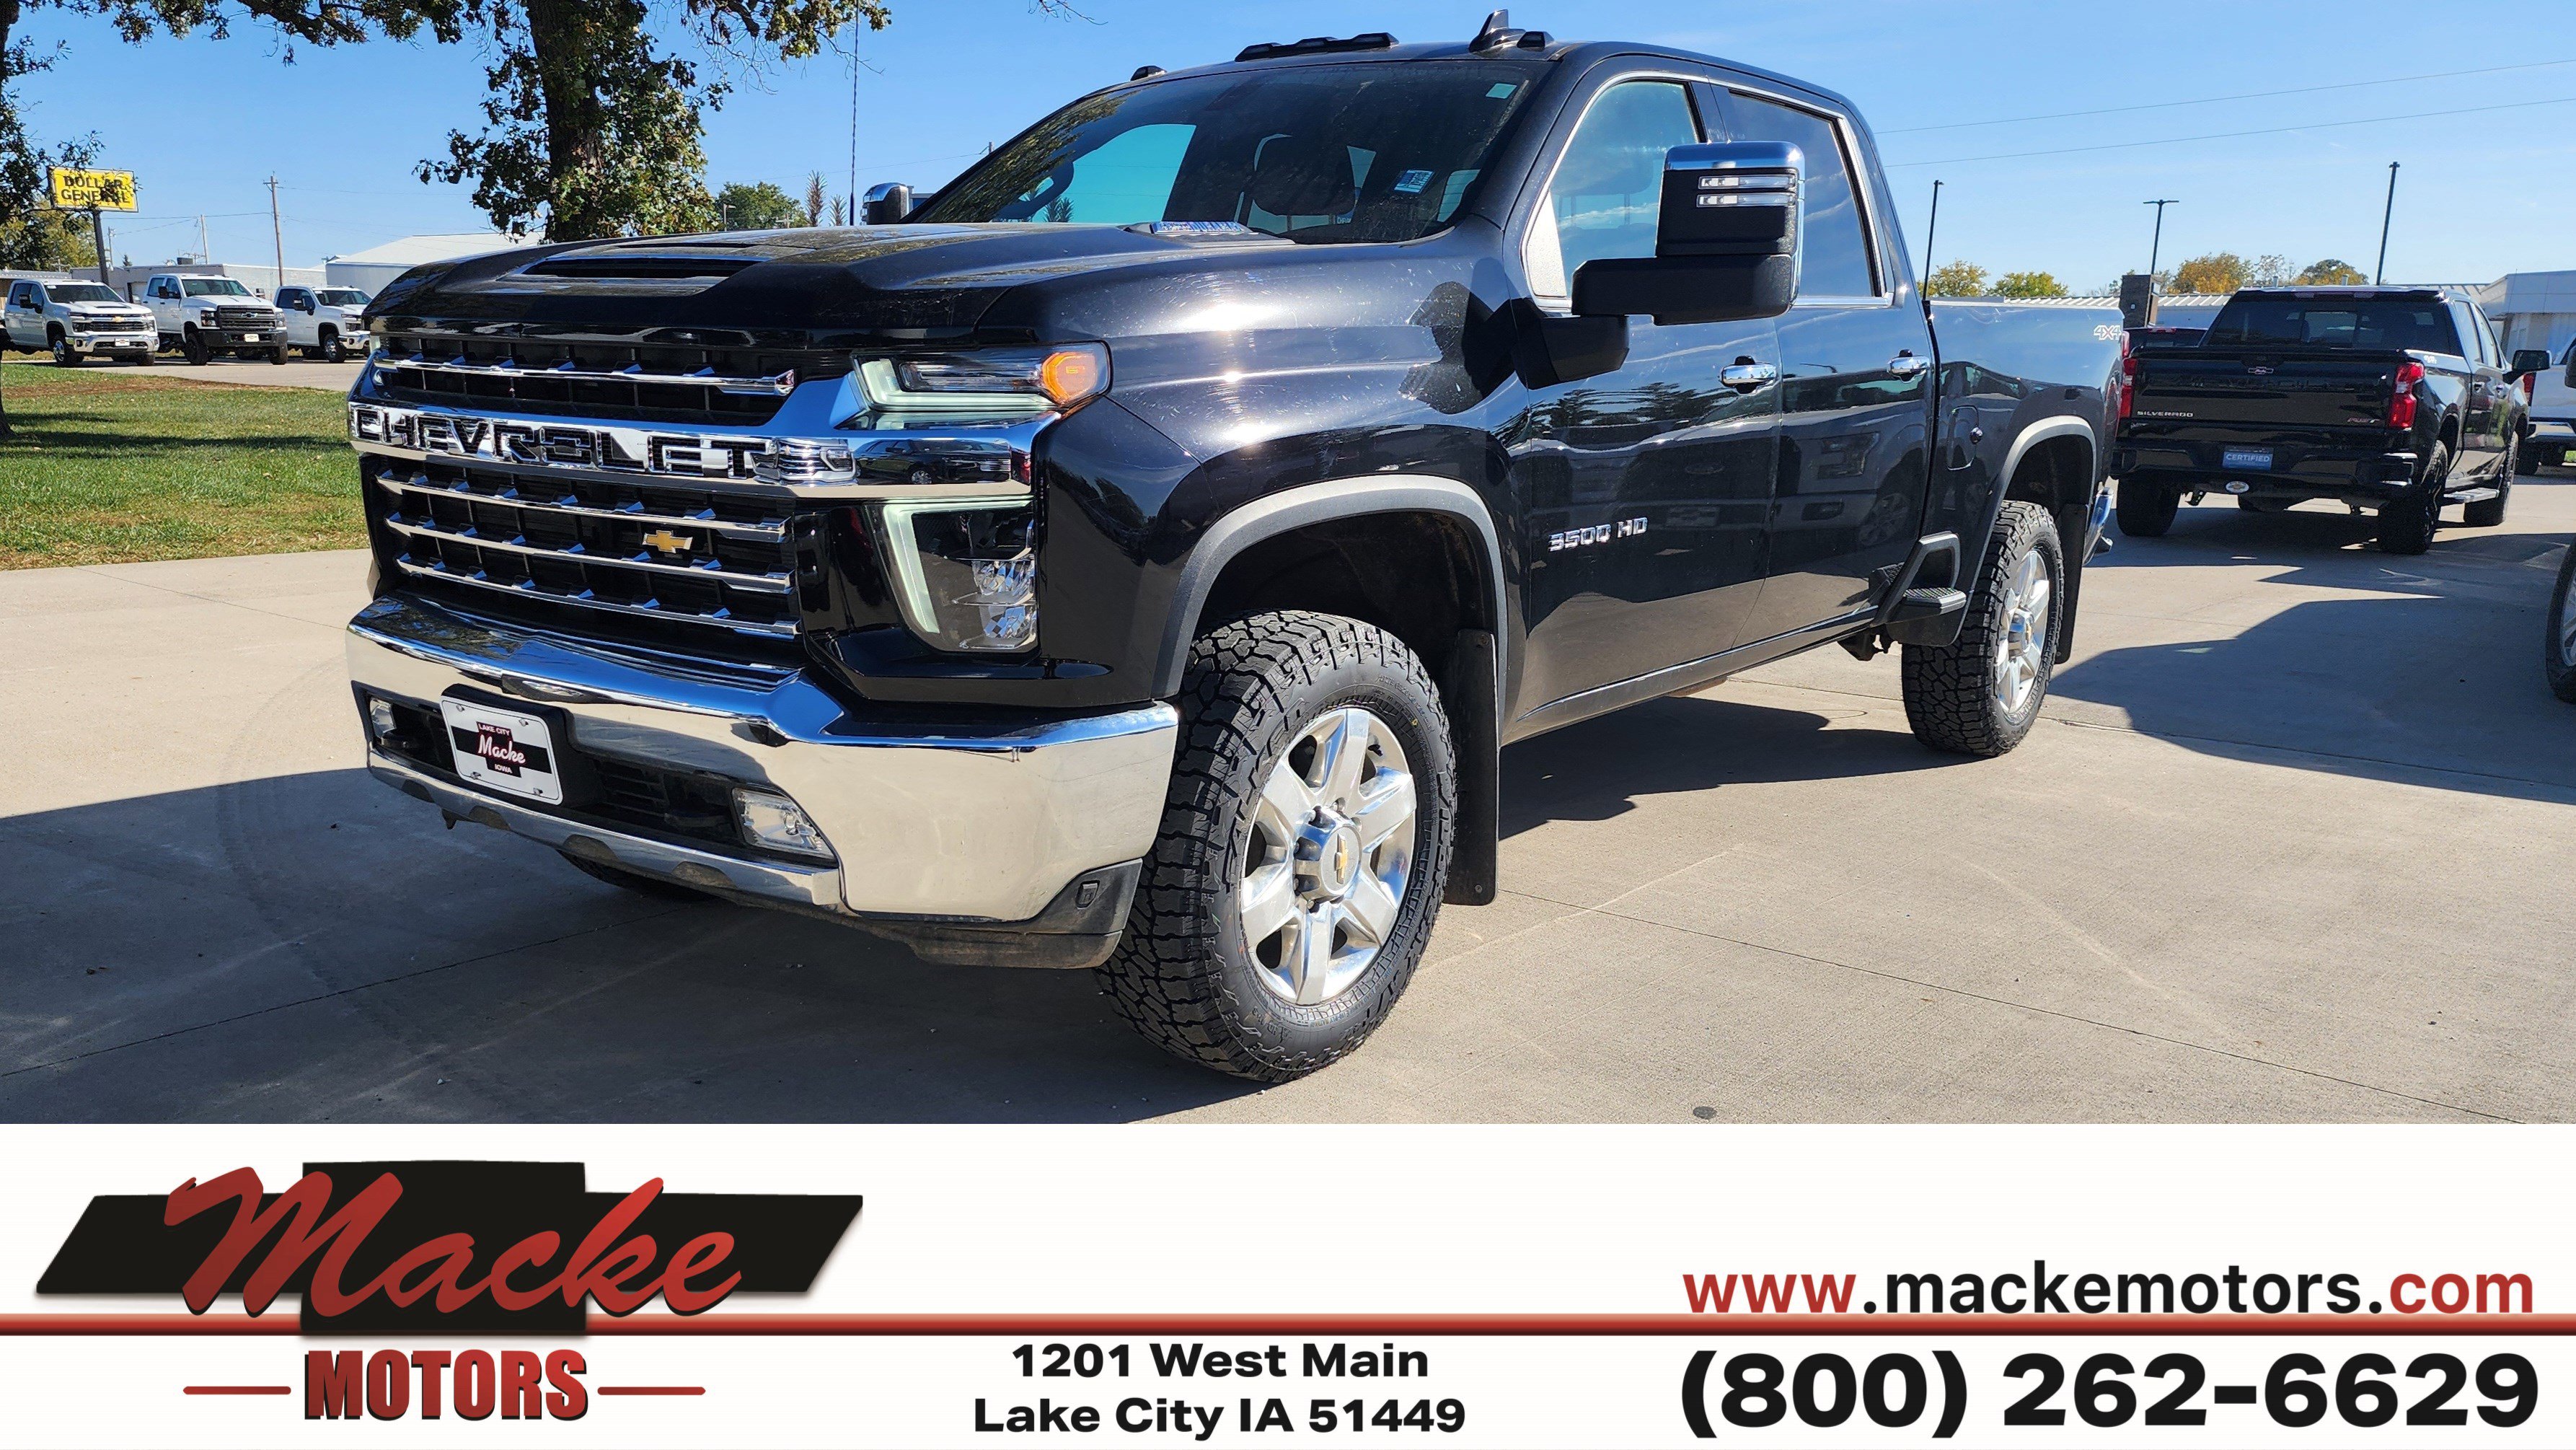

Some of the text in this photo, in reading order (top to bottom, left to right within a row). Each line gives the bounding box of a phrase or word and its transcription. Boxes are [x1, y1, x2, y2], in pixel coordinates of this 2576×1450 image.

[63, 175, 123, 189] DOLLAR
[61, 189, 131, 202] GENEL
[350, 408, 776, 479] CHEVROLET
[2226, 453, 2271, 462] CERTIFIED
[1548, 517, 1649, 553] 3500 HD
[478, 723, 511, 737] LAKE CITY
[477, 734, 526, 765] Macke
[494, 763, 513, 774] IOWA
